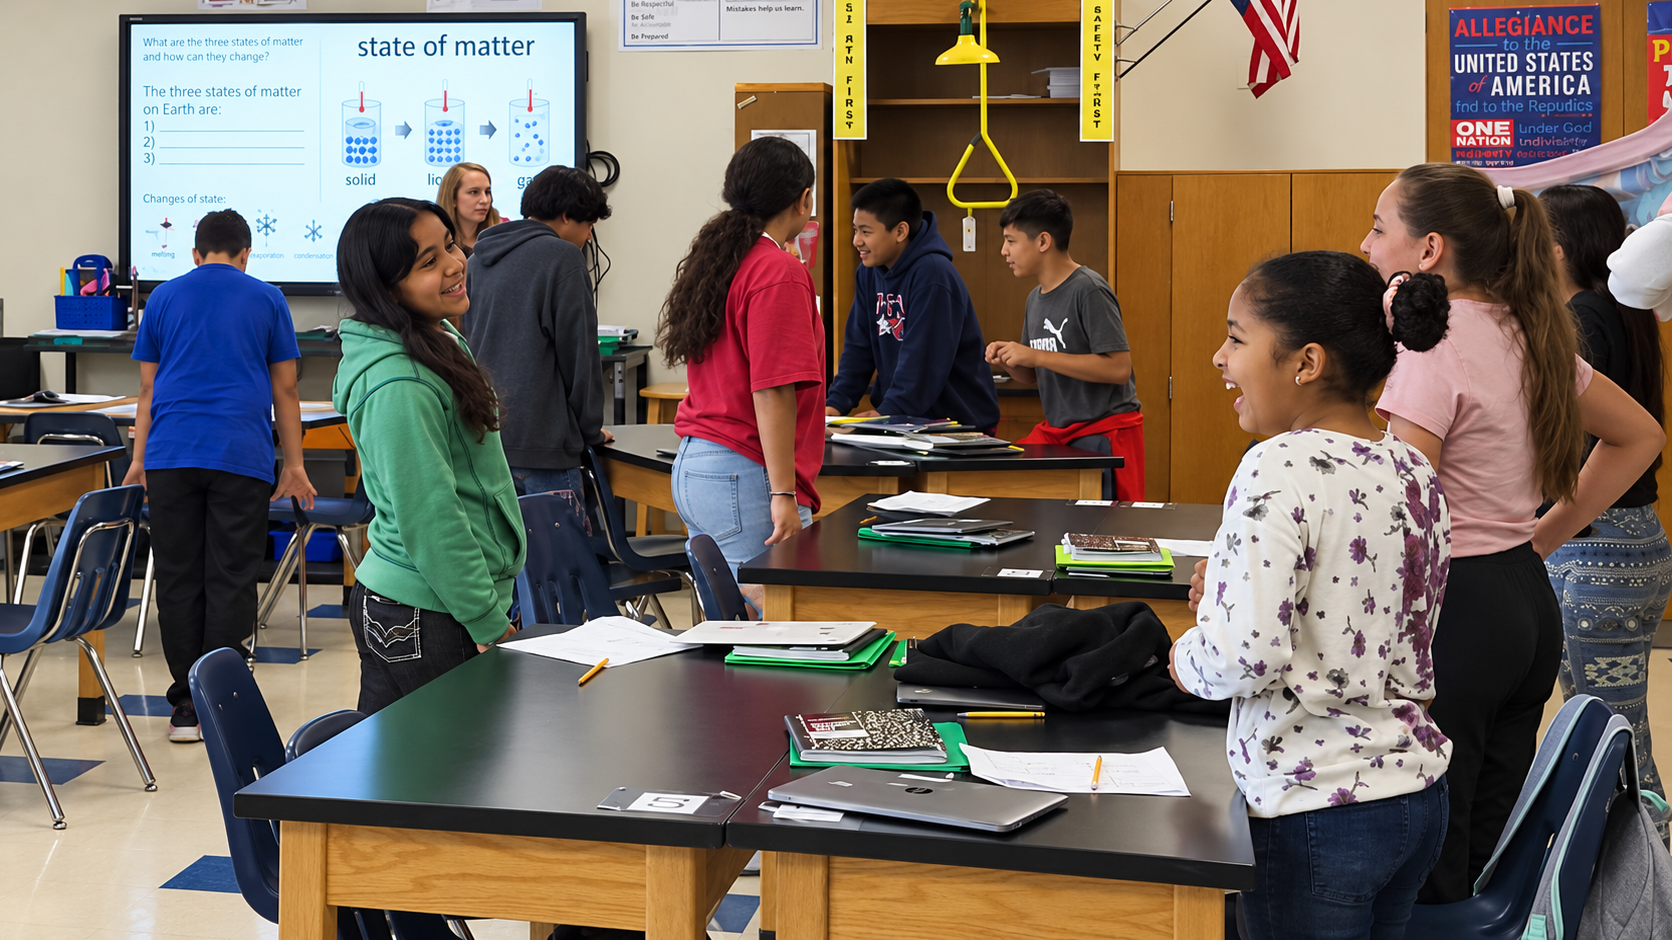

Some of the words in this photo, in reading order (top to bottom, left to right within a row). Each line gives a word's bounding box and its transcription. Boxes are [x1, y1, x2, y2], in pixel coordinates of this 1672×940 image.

[758, 5, 773, 13] help
[1454, 14, 1594, 37] ALLEGIANCE
[143, 37, 168, 47] What
[170, 39, 185, 47] are
[187, 38, 202, 47] the
[205, 37, 229, 47] three
[231, 37, 259, 47] states
[260, 37, 270, 47] of
[272, 37, 303, 46] matter
[358, 37, 415, 57] state
[423, 34, 447, 57] of
[455, 36, 535, 57] matter
[1503, 38, 1519, 51] to
[1524, 37, 1551, 50] the
[143, 52, 161, 62] and
[163, 52, 184, 62] how
[186, 53, 204, 62] can
[206, 52, 227, 63] they
[229, 51, 269, 63] change?
[1454, 53, 1518, 74] UNITED
[1525, 51, 1594, 72] STATES
[143, 85, 166, 97] The
[170, 85, 202, 97] three
[205, 86, 241, 97] states
[244, 85, 257, 97] of
[260, 86, 301, 97] matter
[1468, 75, 1487, 93] of
[1490, 74, 1591, 96] AMERICA
[143, 106, 158, 115] on
[163, 103, 195, 115] Earth
[198, 105, 221, 115] are:
[1482, 101, 1497, 113] to
[1501, 99, 1524, 112] the
[144, 120, 155, 133] 1)
[1456, 121, 1511, 136] ONE
[1519, 122, 1559, 134] under
[1563, 122, 1592, 133] God
[143, 136, 155, 150] 2)
[1456, 136, 1511, 146] NATION
[143, 152, 155, 165] 3)
[345, 173, 376, 186] solid
[143, 194, 185, 205] Changes
[187, 194, 197, 203] of
[199, 195, 226, 204] state:
